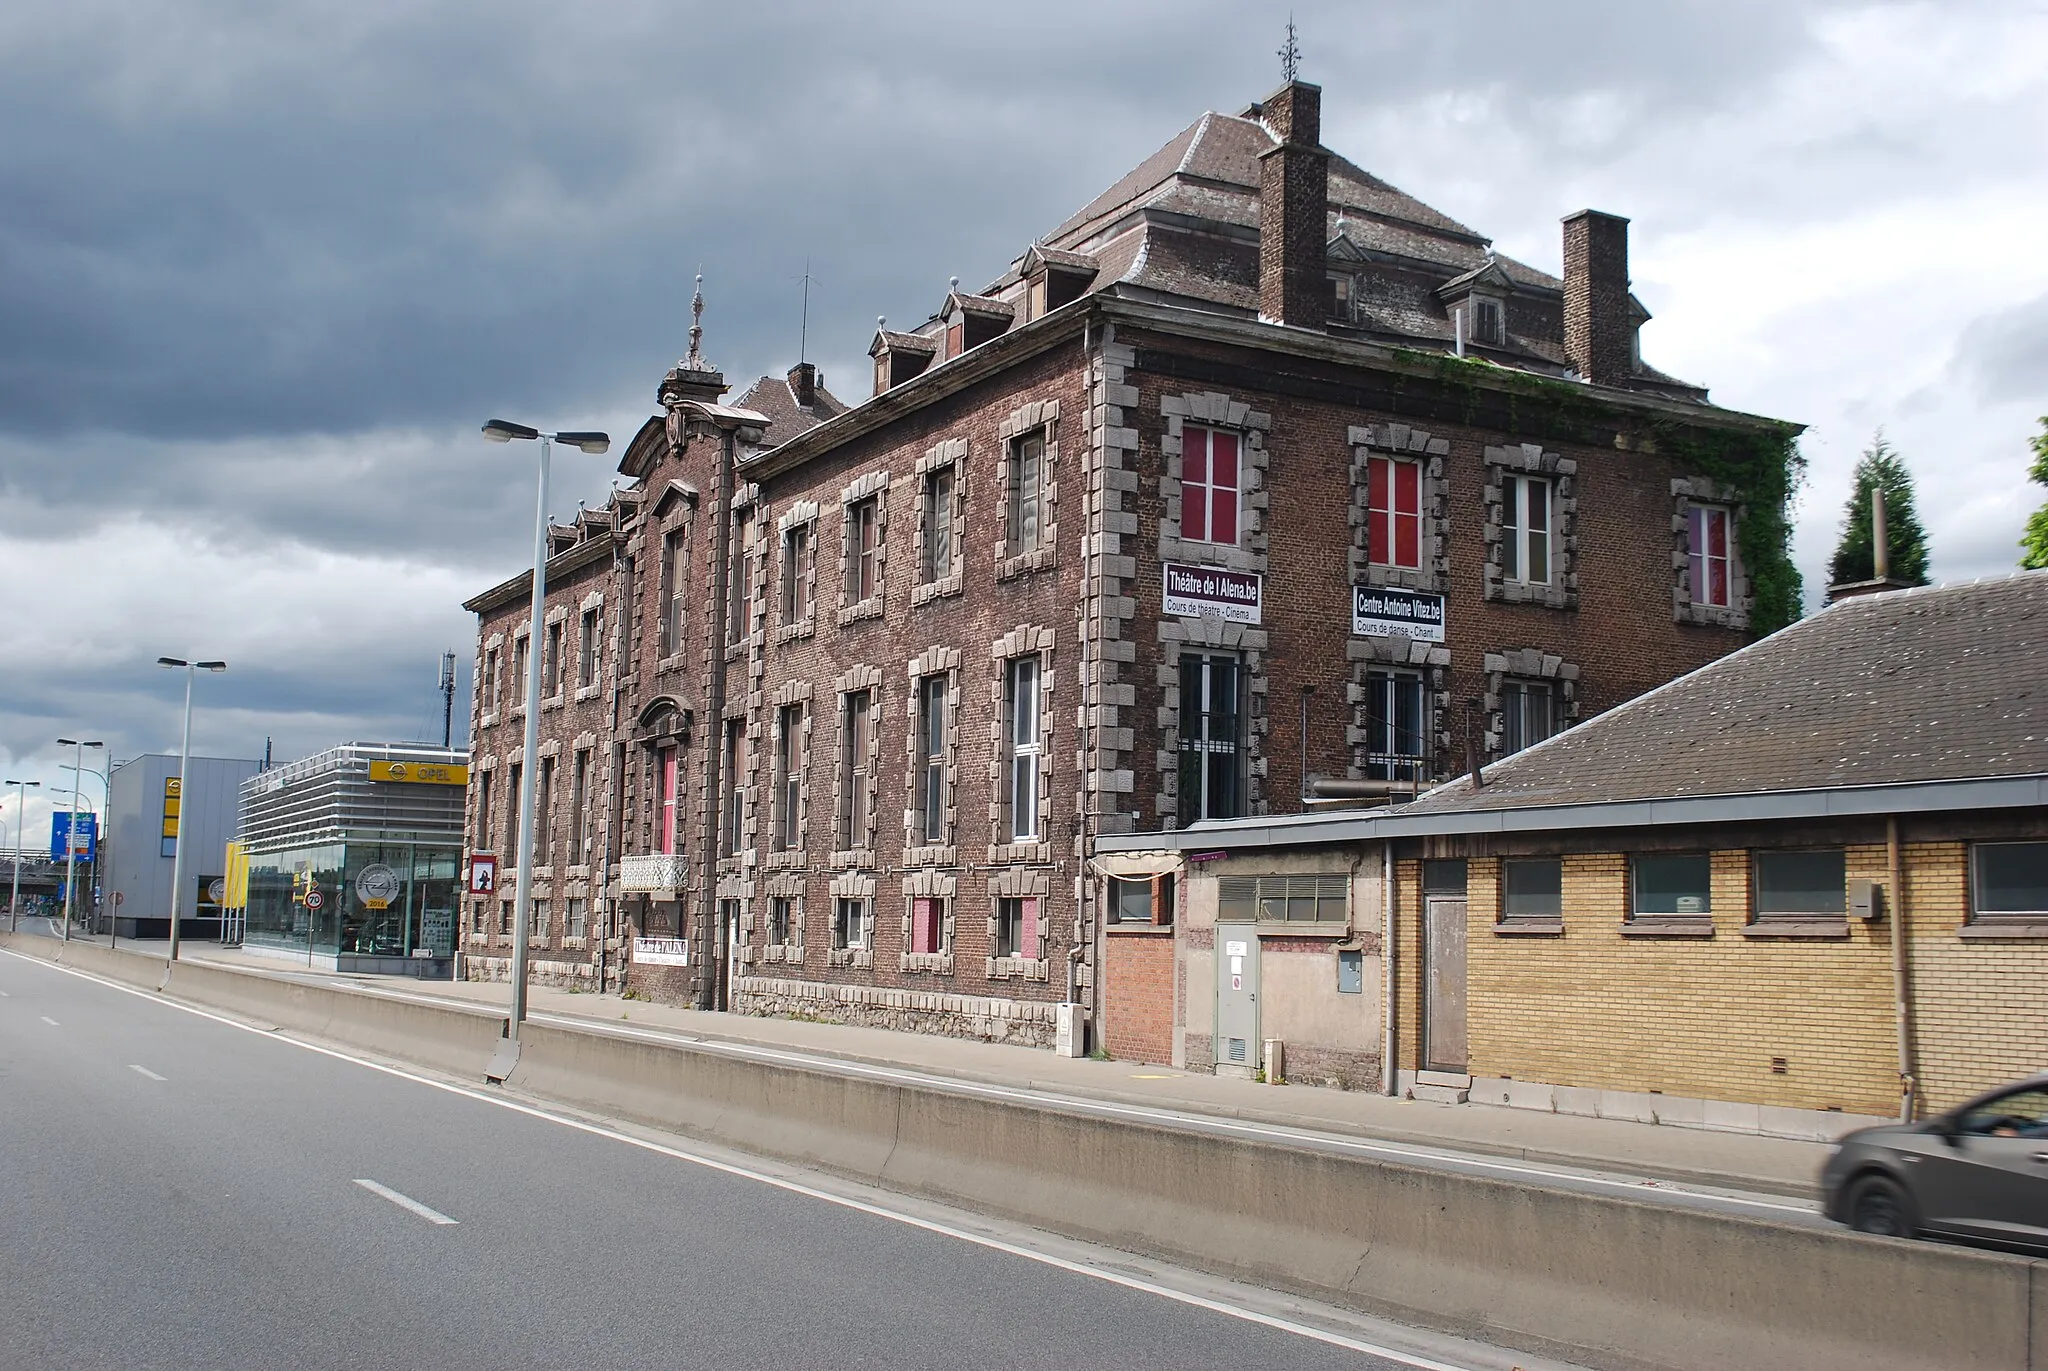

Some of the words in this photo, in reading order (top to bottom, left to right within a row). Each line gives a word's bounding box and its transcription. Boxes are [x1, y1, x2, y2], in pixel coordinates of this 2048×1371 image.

[1169, 571, 1202, 593] Théâtre
[1203, 576, 1214, 595] de
[1220, 578, 1256, 600] Alena.be
[1167, 599, 1187, 612] Cours
[1188, 601, 1197, 613] de
[1225, 606, 1250, 620] Cinéma
[1358, 594, 1383, 613] Centre
[1383, 596, 1412, 617] Antoine
[1412, 600, 1440, 620] Vitez.be
[1357, 620, 1378, 633] Cours
[1379, 622, 1387, 634] de
[1388, 624, 1409, 636] danse
[1414, 626, 1434, 639] Chant
[417, 767, 452, 781] OPEL
[309, 896, 320, 904] 70
[654, 940, 662, 953] de
